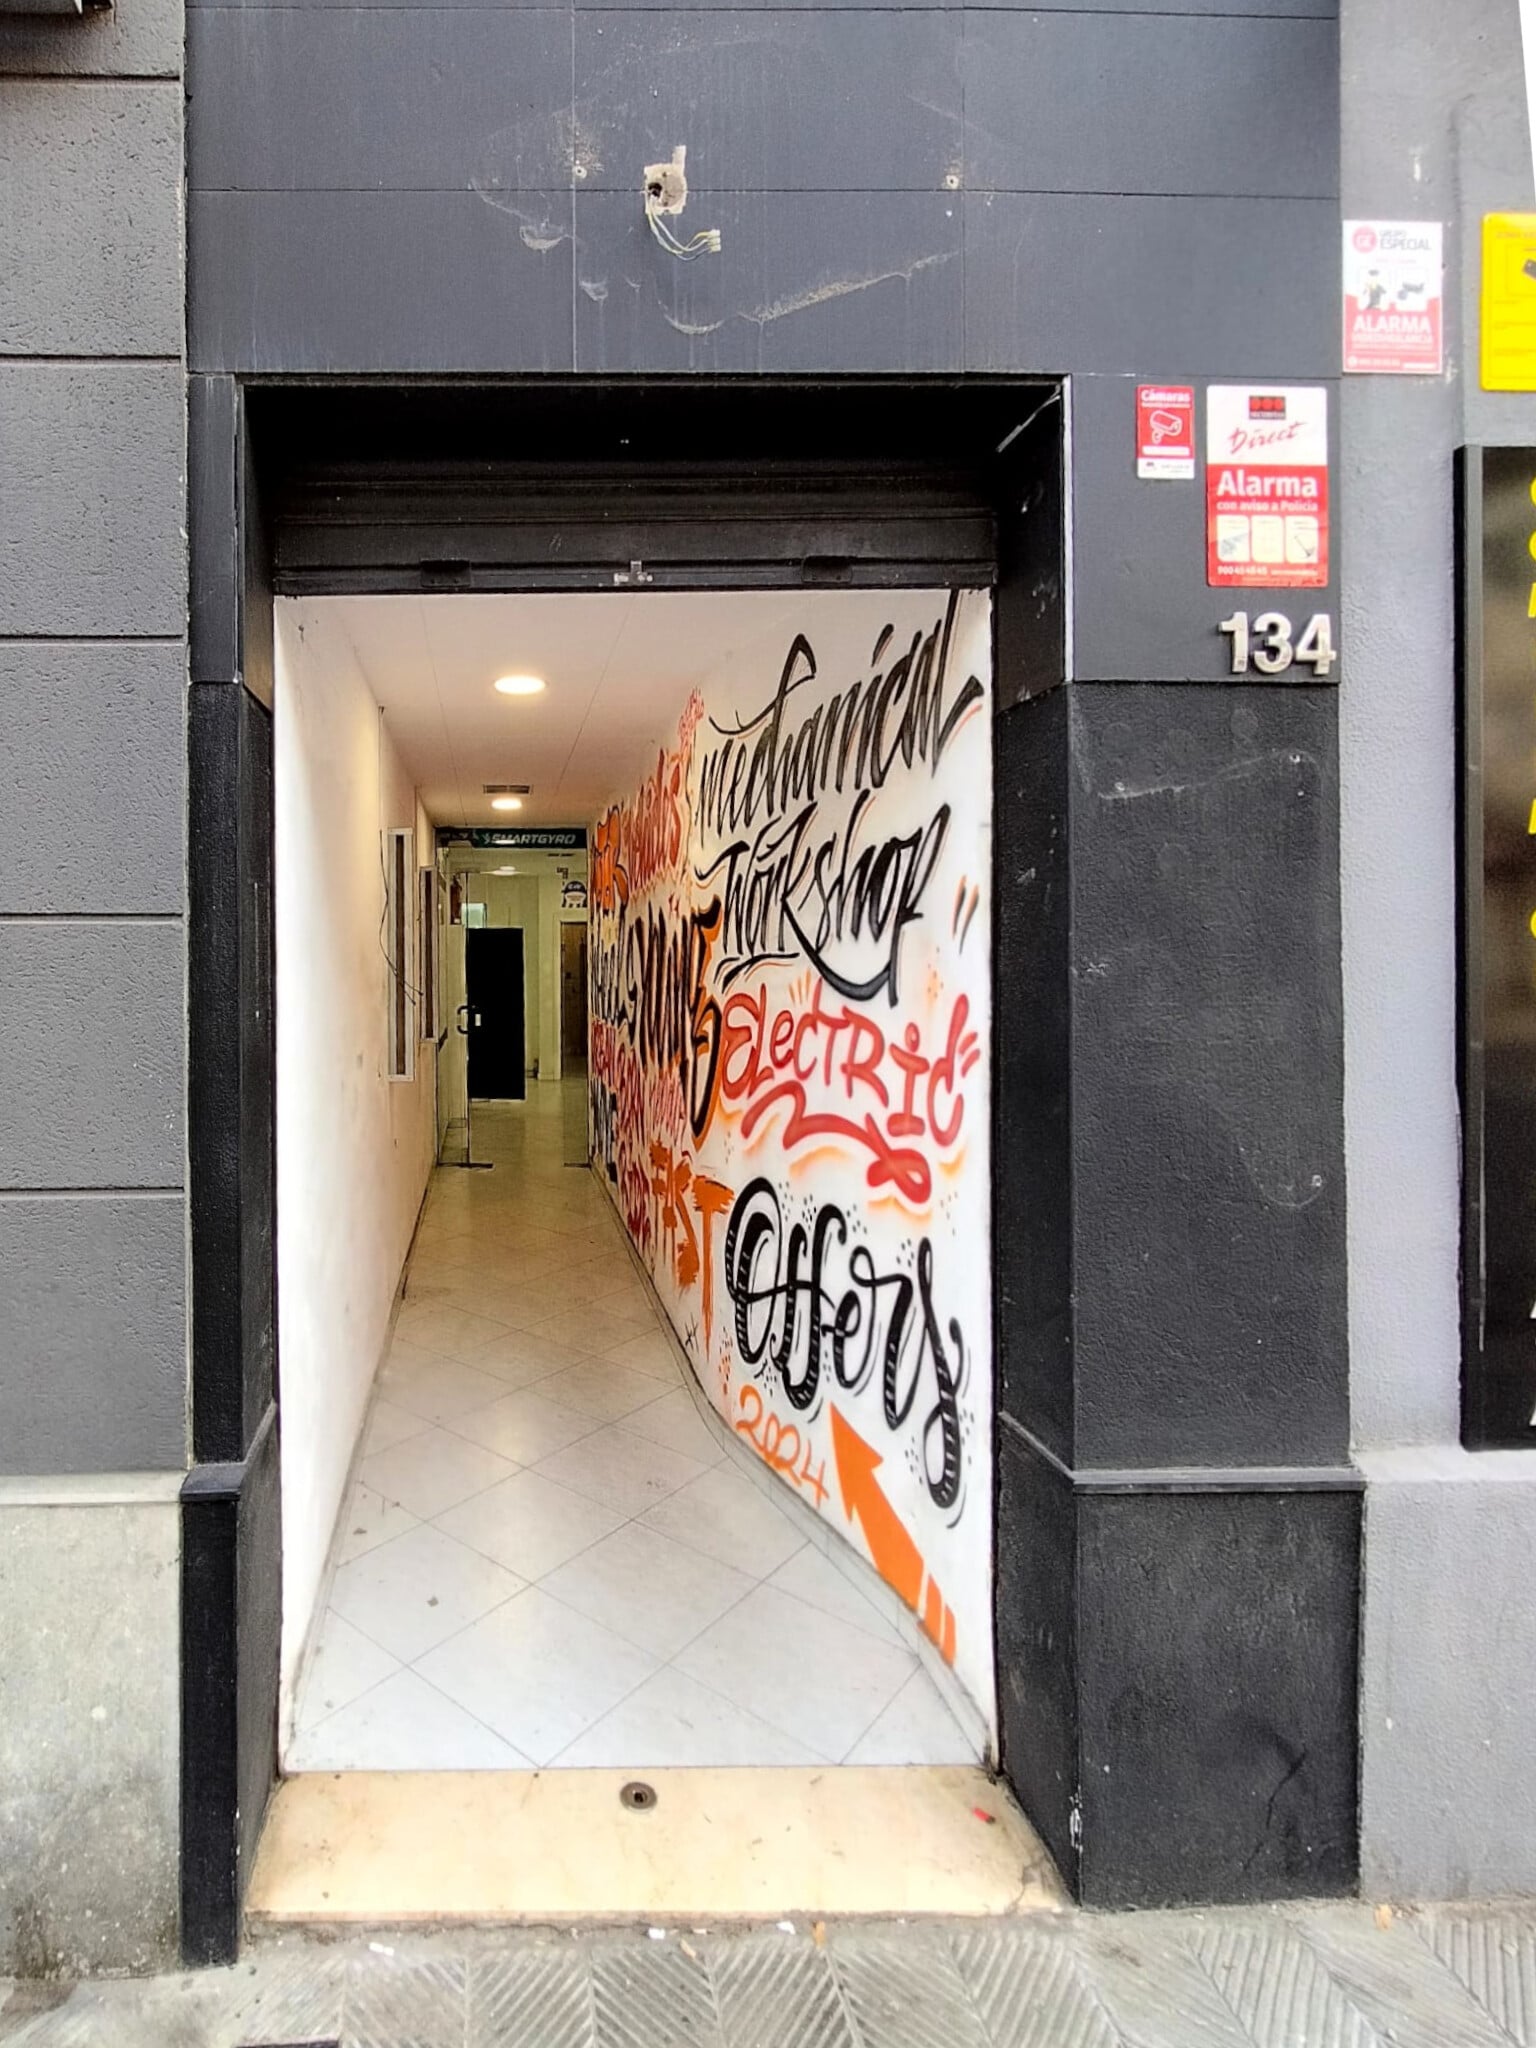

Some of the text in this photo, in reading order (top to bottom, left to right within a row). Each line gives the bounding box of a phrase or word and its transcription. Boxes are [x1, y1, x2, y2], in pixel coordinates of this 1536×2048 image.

[1380, 239, 1431, 251] ESPECIAL
[1353, 315, 1432, 334] ALARMA
[1141, 389, 1191, 403] Cámaras
[1217, 468, 1318, 498] Alarma
[1216, 501, 1238, 511] con
[1240, 499, 1270, 512] aviso
[1271, 502, 1279, 512] a
[1219, 611, 1338, 676] 134
[649, 1138, 735, 1363] FAST
[736, 1384, 831, 1509] 2024
